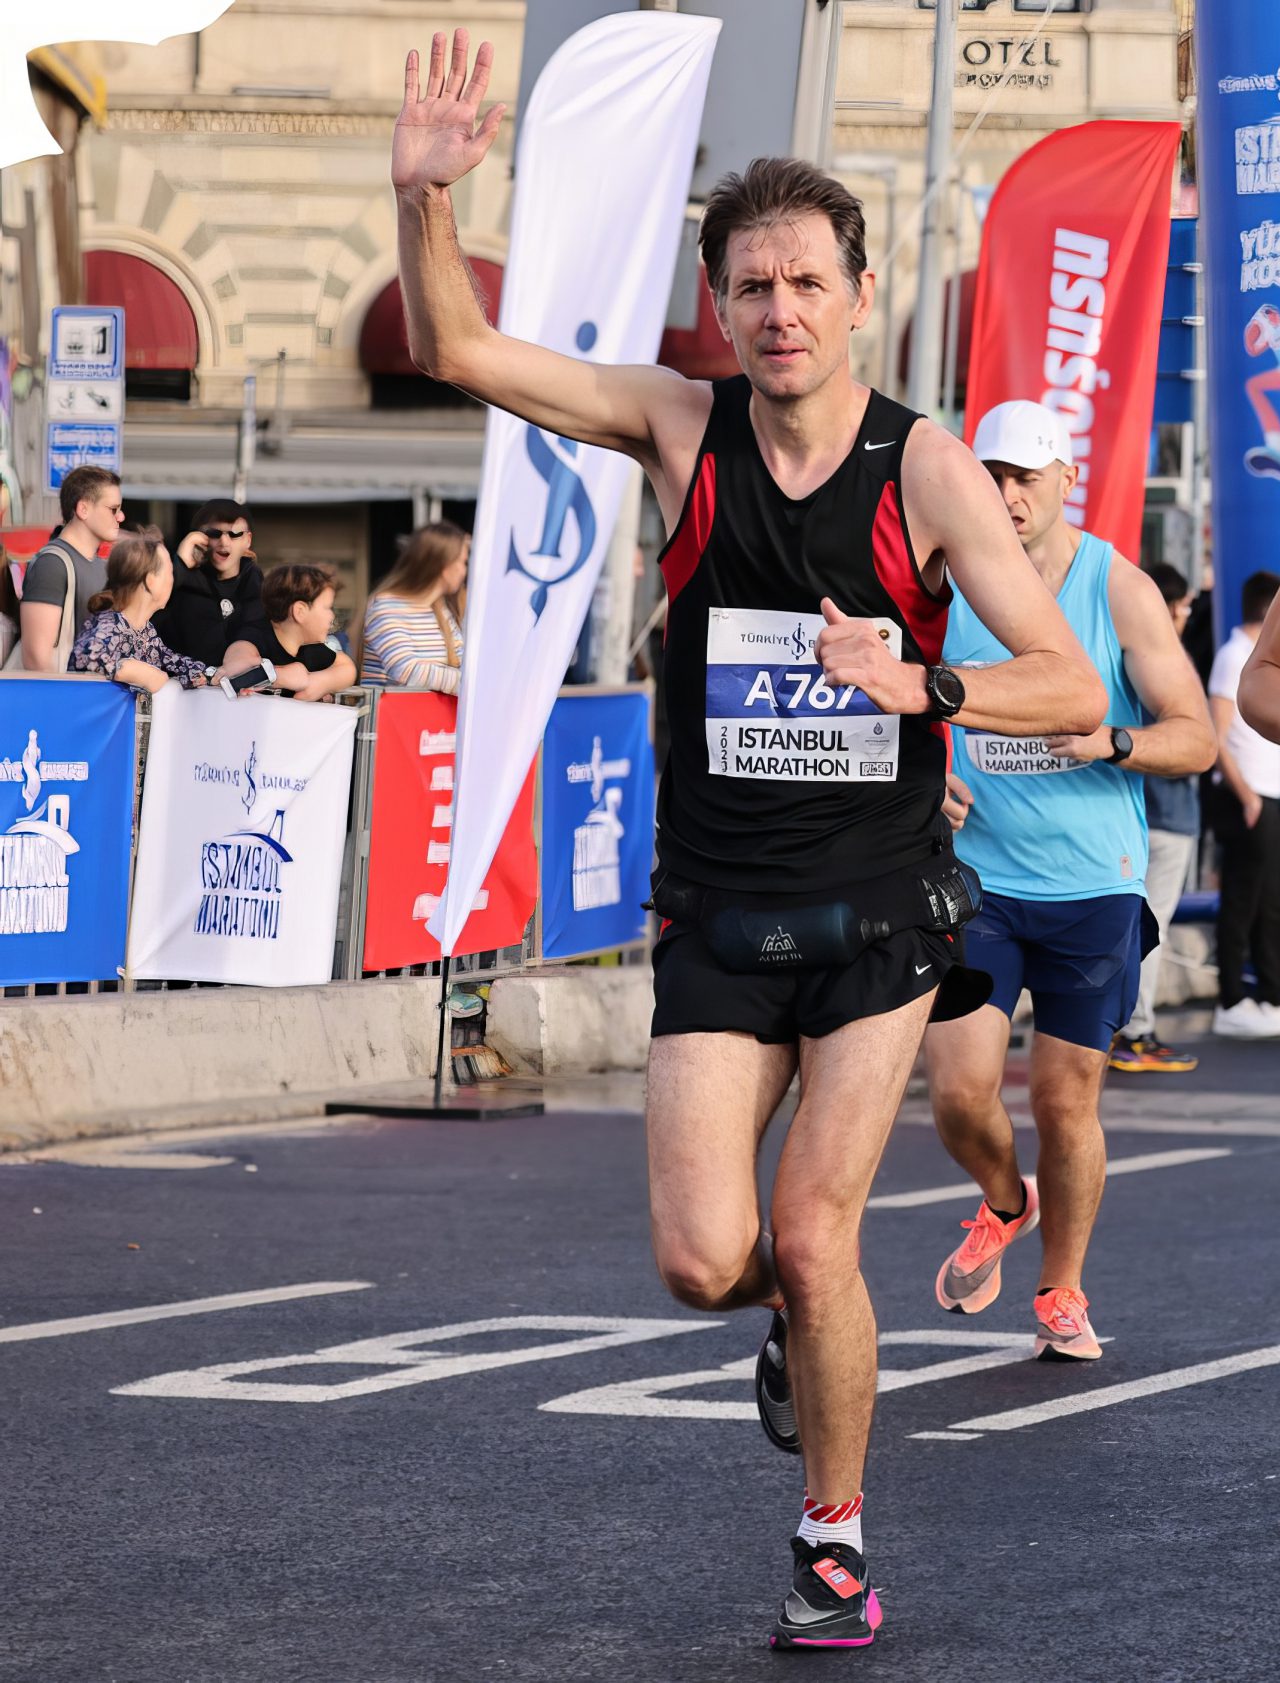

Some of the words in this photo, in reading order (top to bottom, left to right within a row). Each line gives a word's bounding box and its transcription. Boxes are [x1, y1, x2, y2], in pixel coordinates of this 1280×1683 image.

[744, 671, 778, 707] A
[738, 727, 849, 751] ISTANBUL
[985, 741, 1051, 755] ISTANBU
[735, 755, 850, 777] MARATHON
[985, 759, 1061, 771] MARATHON
